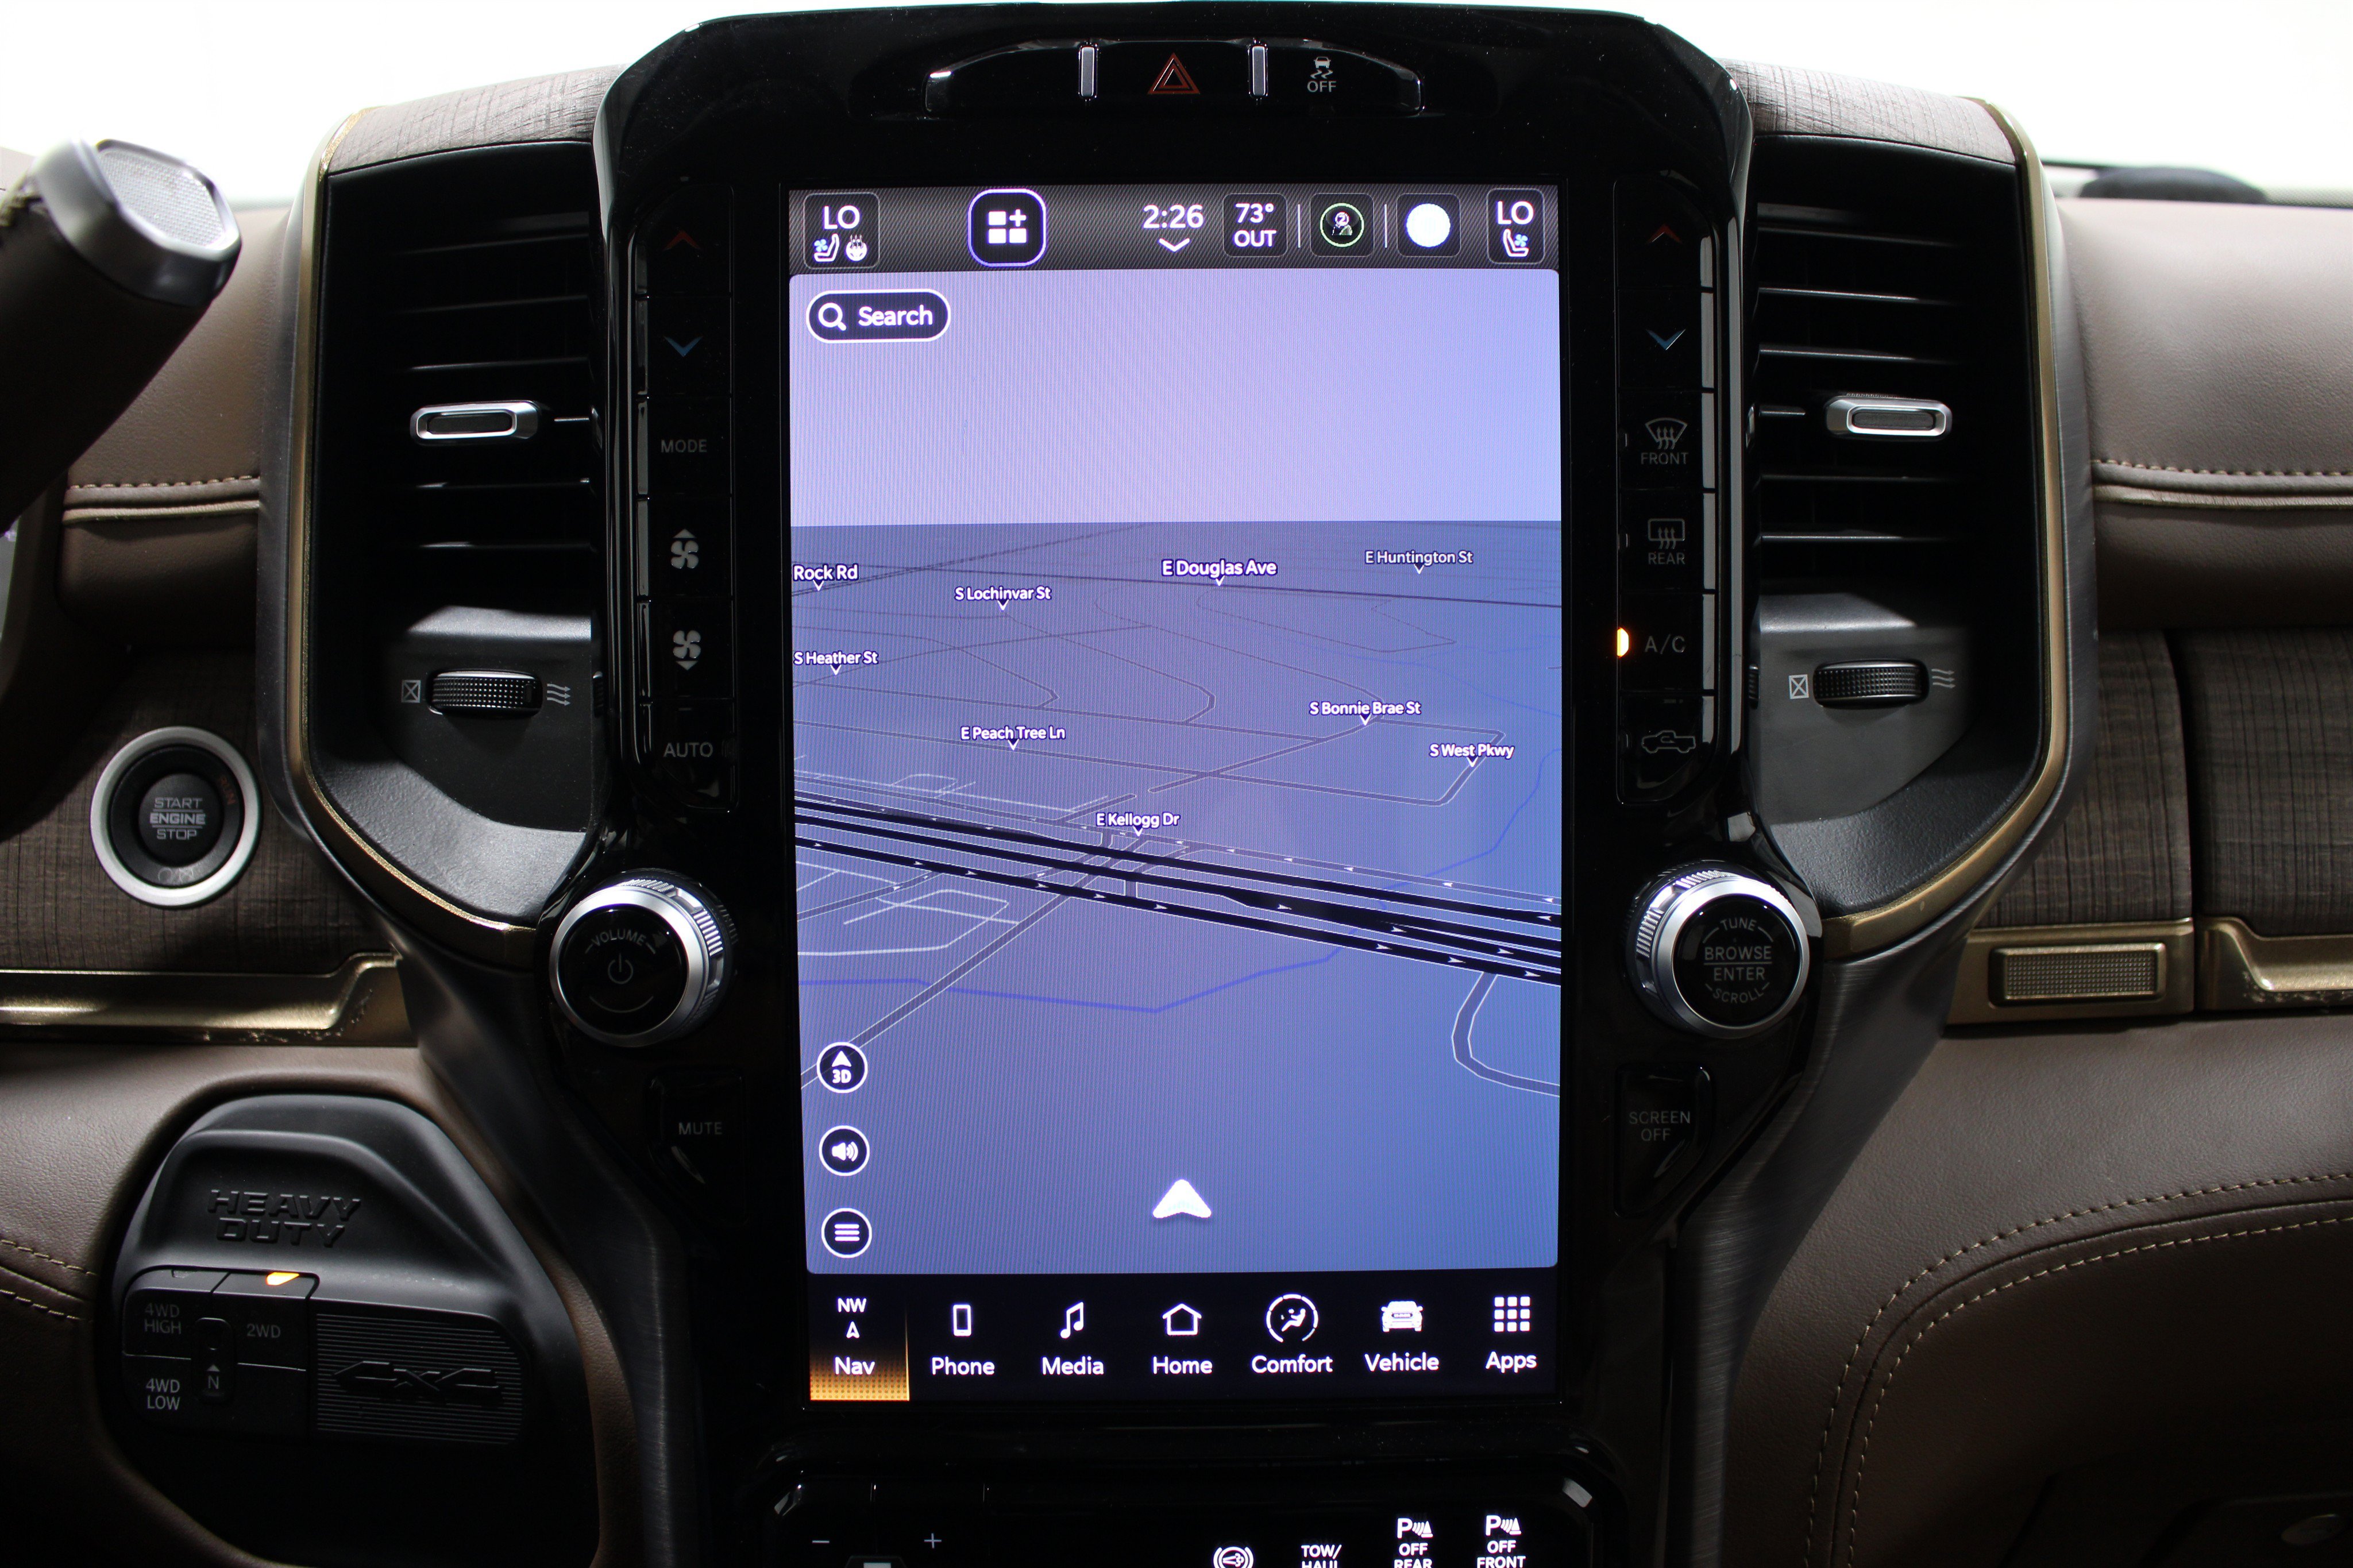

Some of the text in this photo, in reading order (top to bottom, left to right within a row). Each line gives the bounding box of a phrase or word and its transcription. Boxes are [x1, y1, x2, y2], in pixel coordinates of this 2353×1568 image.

[1307, 80, 1336, 92] OFF
[823, 205, 861, 230] LO
[1143, 204, 1203, 229] 2:26
[1497, 201, 1534, 225] LO
[1234, 230, 1276, 248] OUT
[858, 305, 933, 326] Search
[660, 439, 707, 453] MODE
[1641, 452, 1688, 465] FRONT
[1365, 550, 1473, 566] E Huntington St
[1648, 553, 1685, 565] REAR
[793, 565, 858, 580] Rock Rd
[1162, 559, 1277, 578] E Douglas Ave
[955, 586, 1051, 600] S Lochinvar St
[1644, 634, 1687, 655] A/C
[794, 651, 878, 665] S Heather St
[1310, 702, 1421, 715] S Bonnie Brae St
[961, 727, 1066, 740] E Peach Tree Ln
[663, 742, 713, 758] AUTO
[1430, 744, 1514, 761] S West Pkwy
[154, 798, 203, 808] START
[149, 813, 205, 825] ENGINE
[1097, 812, 1179, 829] E Kellogg Dr
[157, 828, 197, 840] STOP
[1721, 917, 1757, 931] TUNE
[591, 929, 647, 947] VOLUME
[1705, 947, 1772, 960] BROWSE
[1714, 967, 1765, 981] ENTER
[1712, 988, 1764, 1003] SCROLL
[832, 1070, 852, 1084] 3D
[1629, 1111, 1690, 1124] SCREEN
[678, 1122, 723, 1135] MUTE
[1641, 1128, 1671, 1141] OFF
[208, 1188, 361, 1222] HEAVY
[216, 1216, 345, 1248] DUTY
[144, 1303, 180, 1318] 4WD
[838, 1298, 866, 1312] NW
[144, 1319, 182, 1335] HIGH
[246, 1323, 281, 1339] 2WD
[835, 1357, 875, 1374] Nav
[932, 1357, 995, 1377] Phone
[1042, 1357, 1104, 1374] Media
[1153, 1357, 1213, 1374] Home
[1251, 1354, 1333, 1373] Comfort
[1364, 1352, 1439, 1372] Vehicle
[1486, 1351, 1537, 1373] Apps
[145, 1378, 180, 1394] 4WD
[207, 1376, 219, 1389] N
[146, 1395, 180, 1411] LOW
[1301, 1544, 1342, 1559] TOW/
[1399, 1543, 1428, 1556] OFF
[1487, 1540, 1516, 1553] OFF
[1394, 1559, 1432, 1568] REAR
[1477, 1556, 1526, 1568] FRONT
